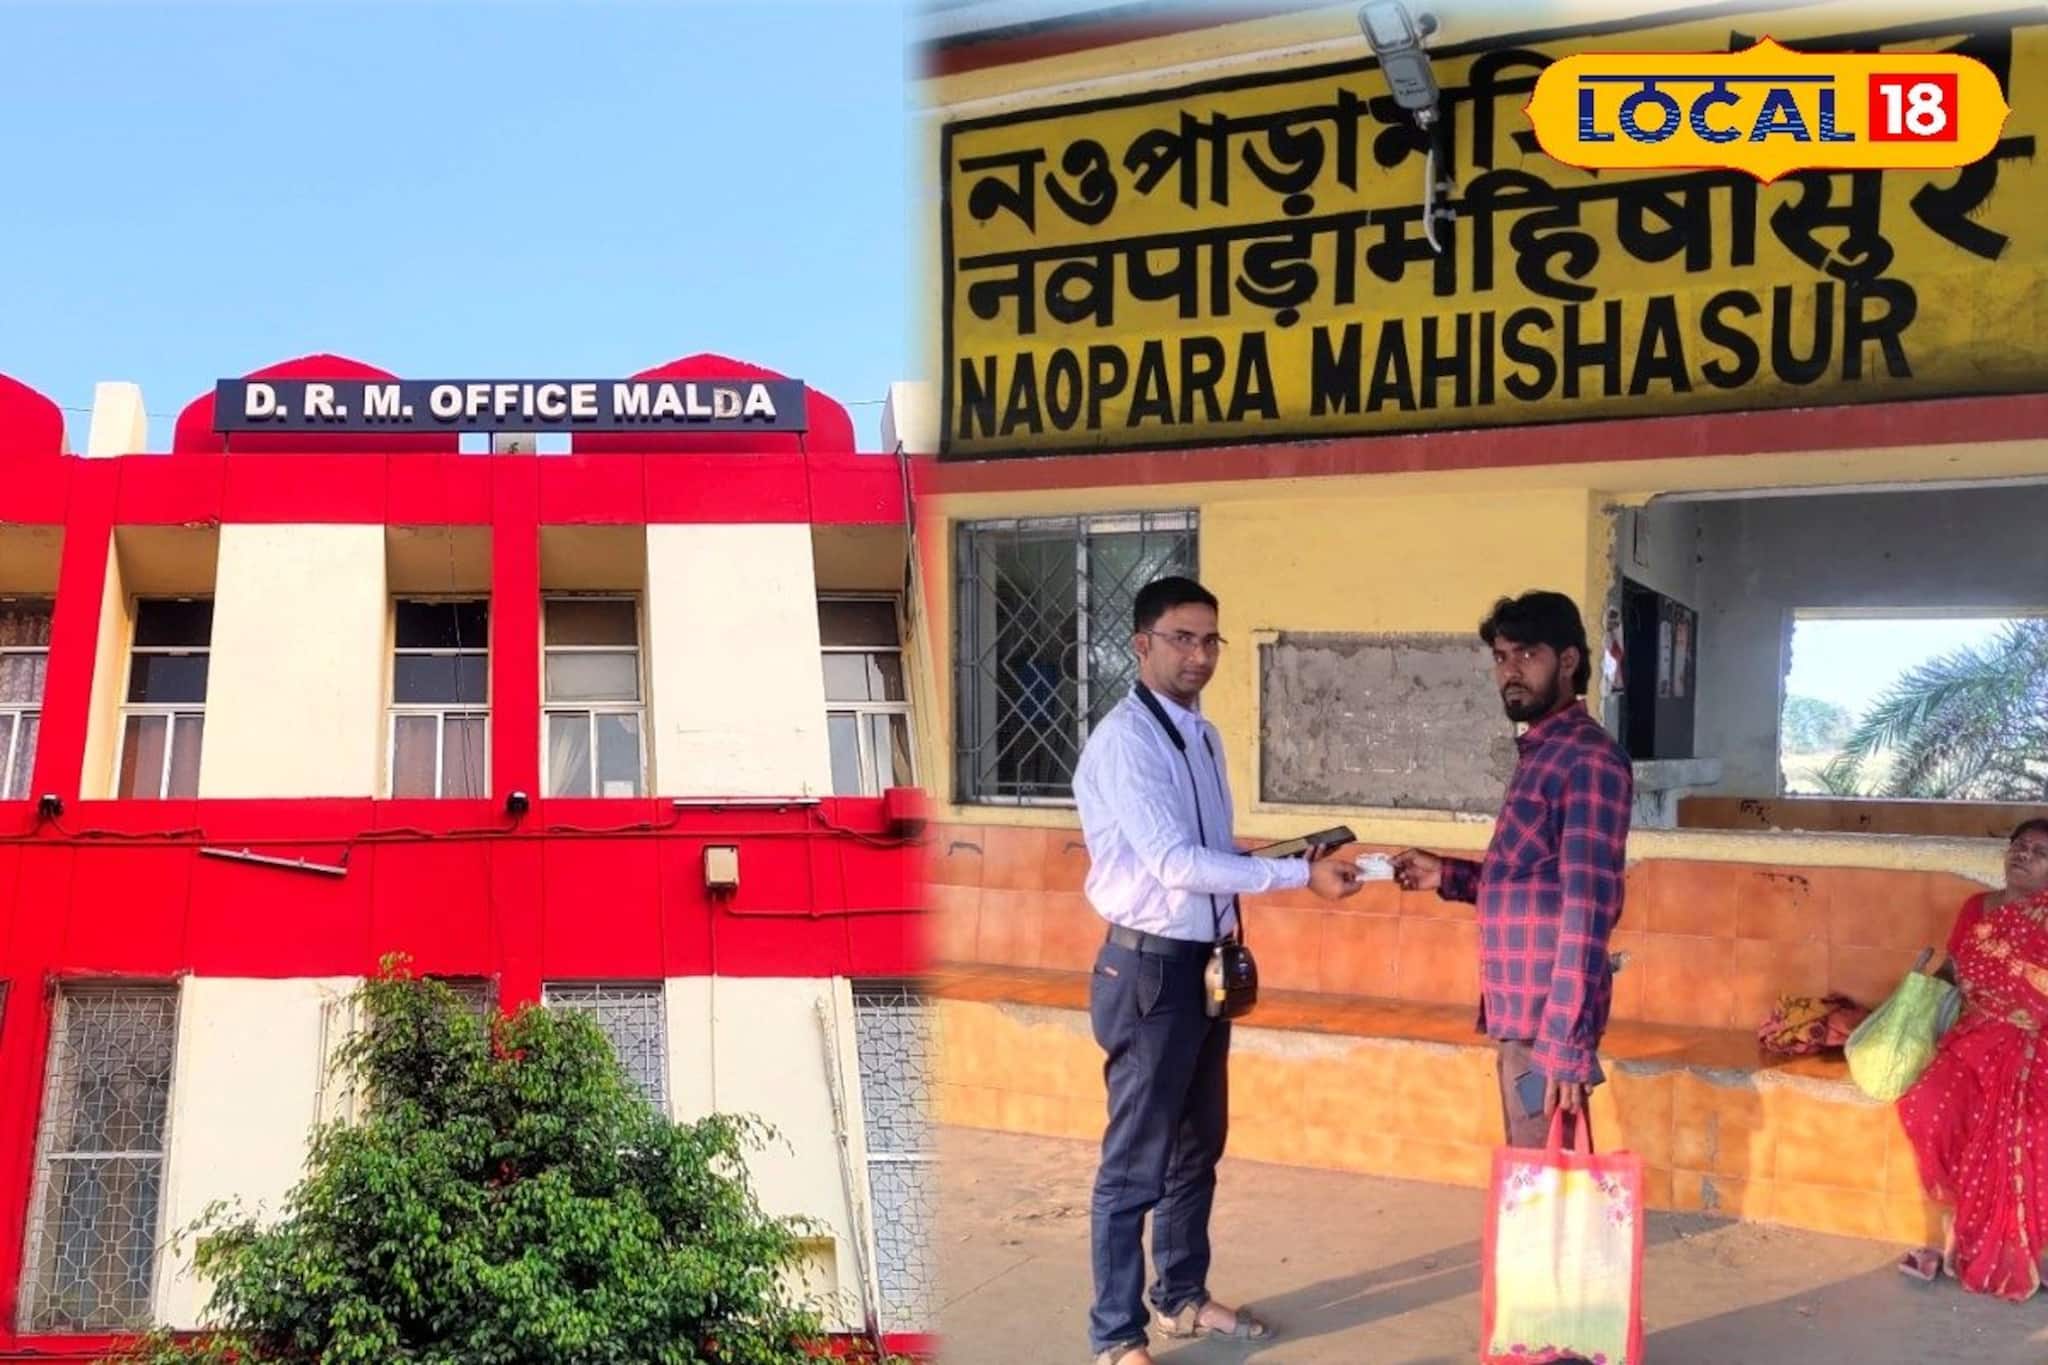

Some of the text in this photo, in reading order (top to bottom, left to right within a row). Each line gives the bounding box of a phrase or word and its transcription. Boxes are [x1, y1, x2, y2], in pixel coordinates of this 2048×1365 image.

[246, 382, 776, 418] D. R. M. OFFICE MALDA
[958, 278, 1914, 440] NAOPARA MAHISHASUR
